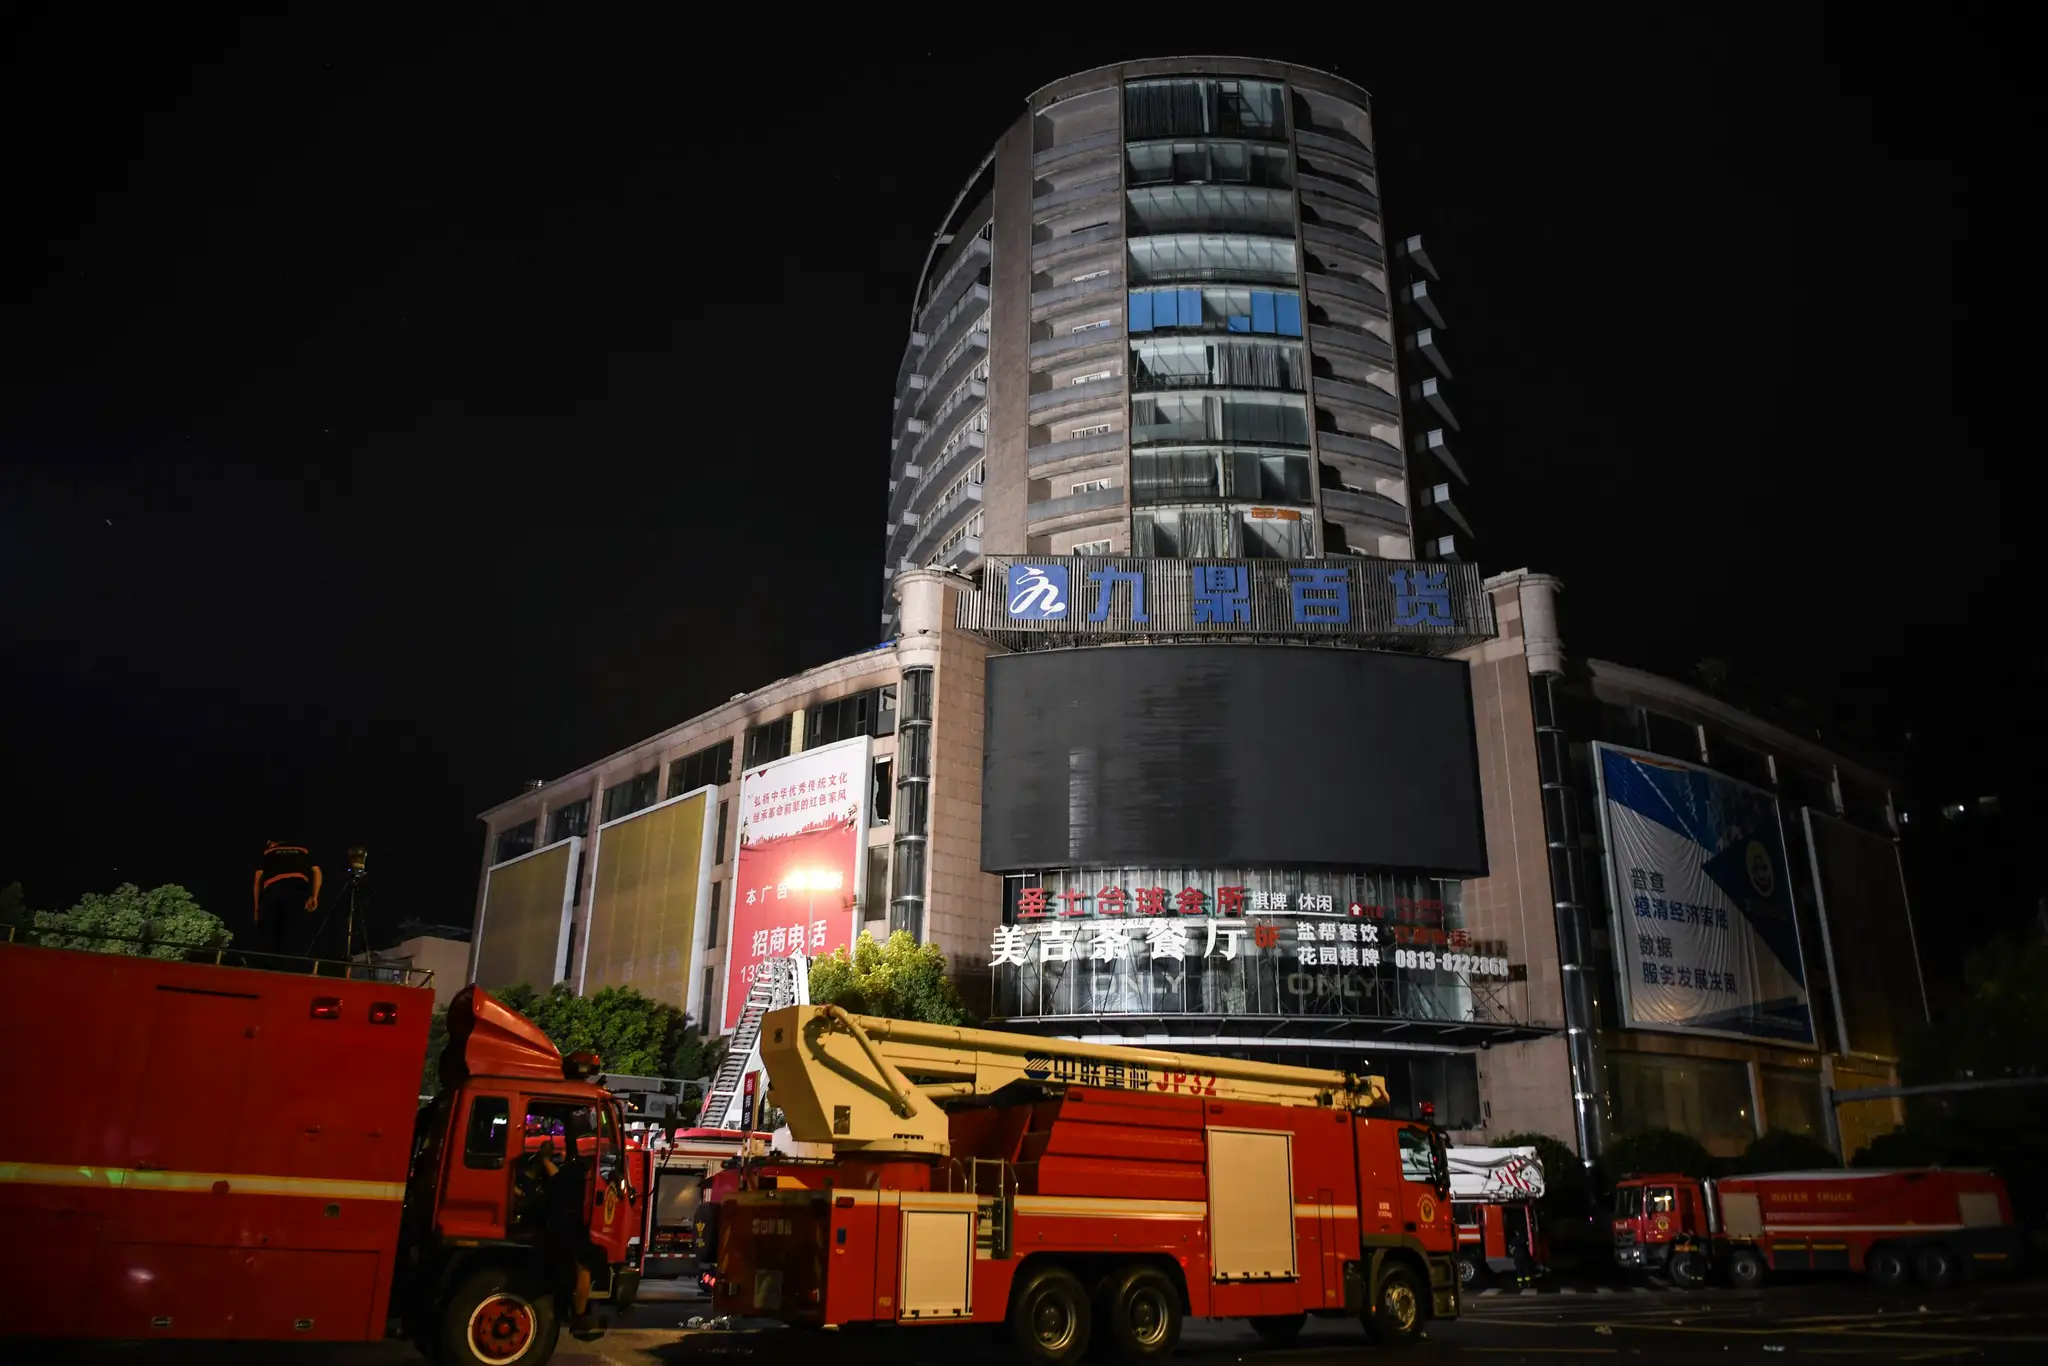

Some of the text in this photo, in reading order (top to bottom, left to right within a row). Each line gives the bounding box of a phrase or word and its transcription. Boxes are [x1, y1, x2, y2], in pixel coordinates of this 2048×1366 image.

[1087, 563, 1455, 627] 九鼎百货
[754, 771, 848, 807] 弘扬中华优秀传统文化
[752, 789, 847, 824] 继承革命前辈的红色家风
[1631, 868, 1666, 893] 普查
[1017, 885, 1333, 918] 圣士台球会所 棋牌 休闲
[751, 919, 828, 958] 招商电话
[988, 918, 1248, 967] 美吉茶餐厅
[1296, 921, 1380, 943] 盐帮餐饮
[1638, 934, 1673, 958] 数据
[1297, 946, 1509, 977] 花园棋牌 0813-8222868
[1642, 961, 1738, 993] 服务发展决策
[1090, 971, 1184, 995] ONLY
[1287, 973, 1377, 998] ONLY
[1053, 1056, 1218, 1096] 中联重科 JP32
[1771, 1191, 1854, 1202] WATER TRUCK
